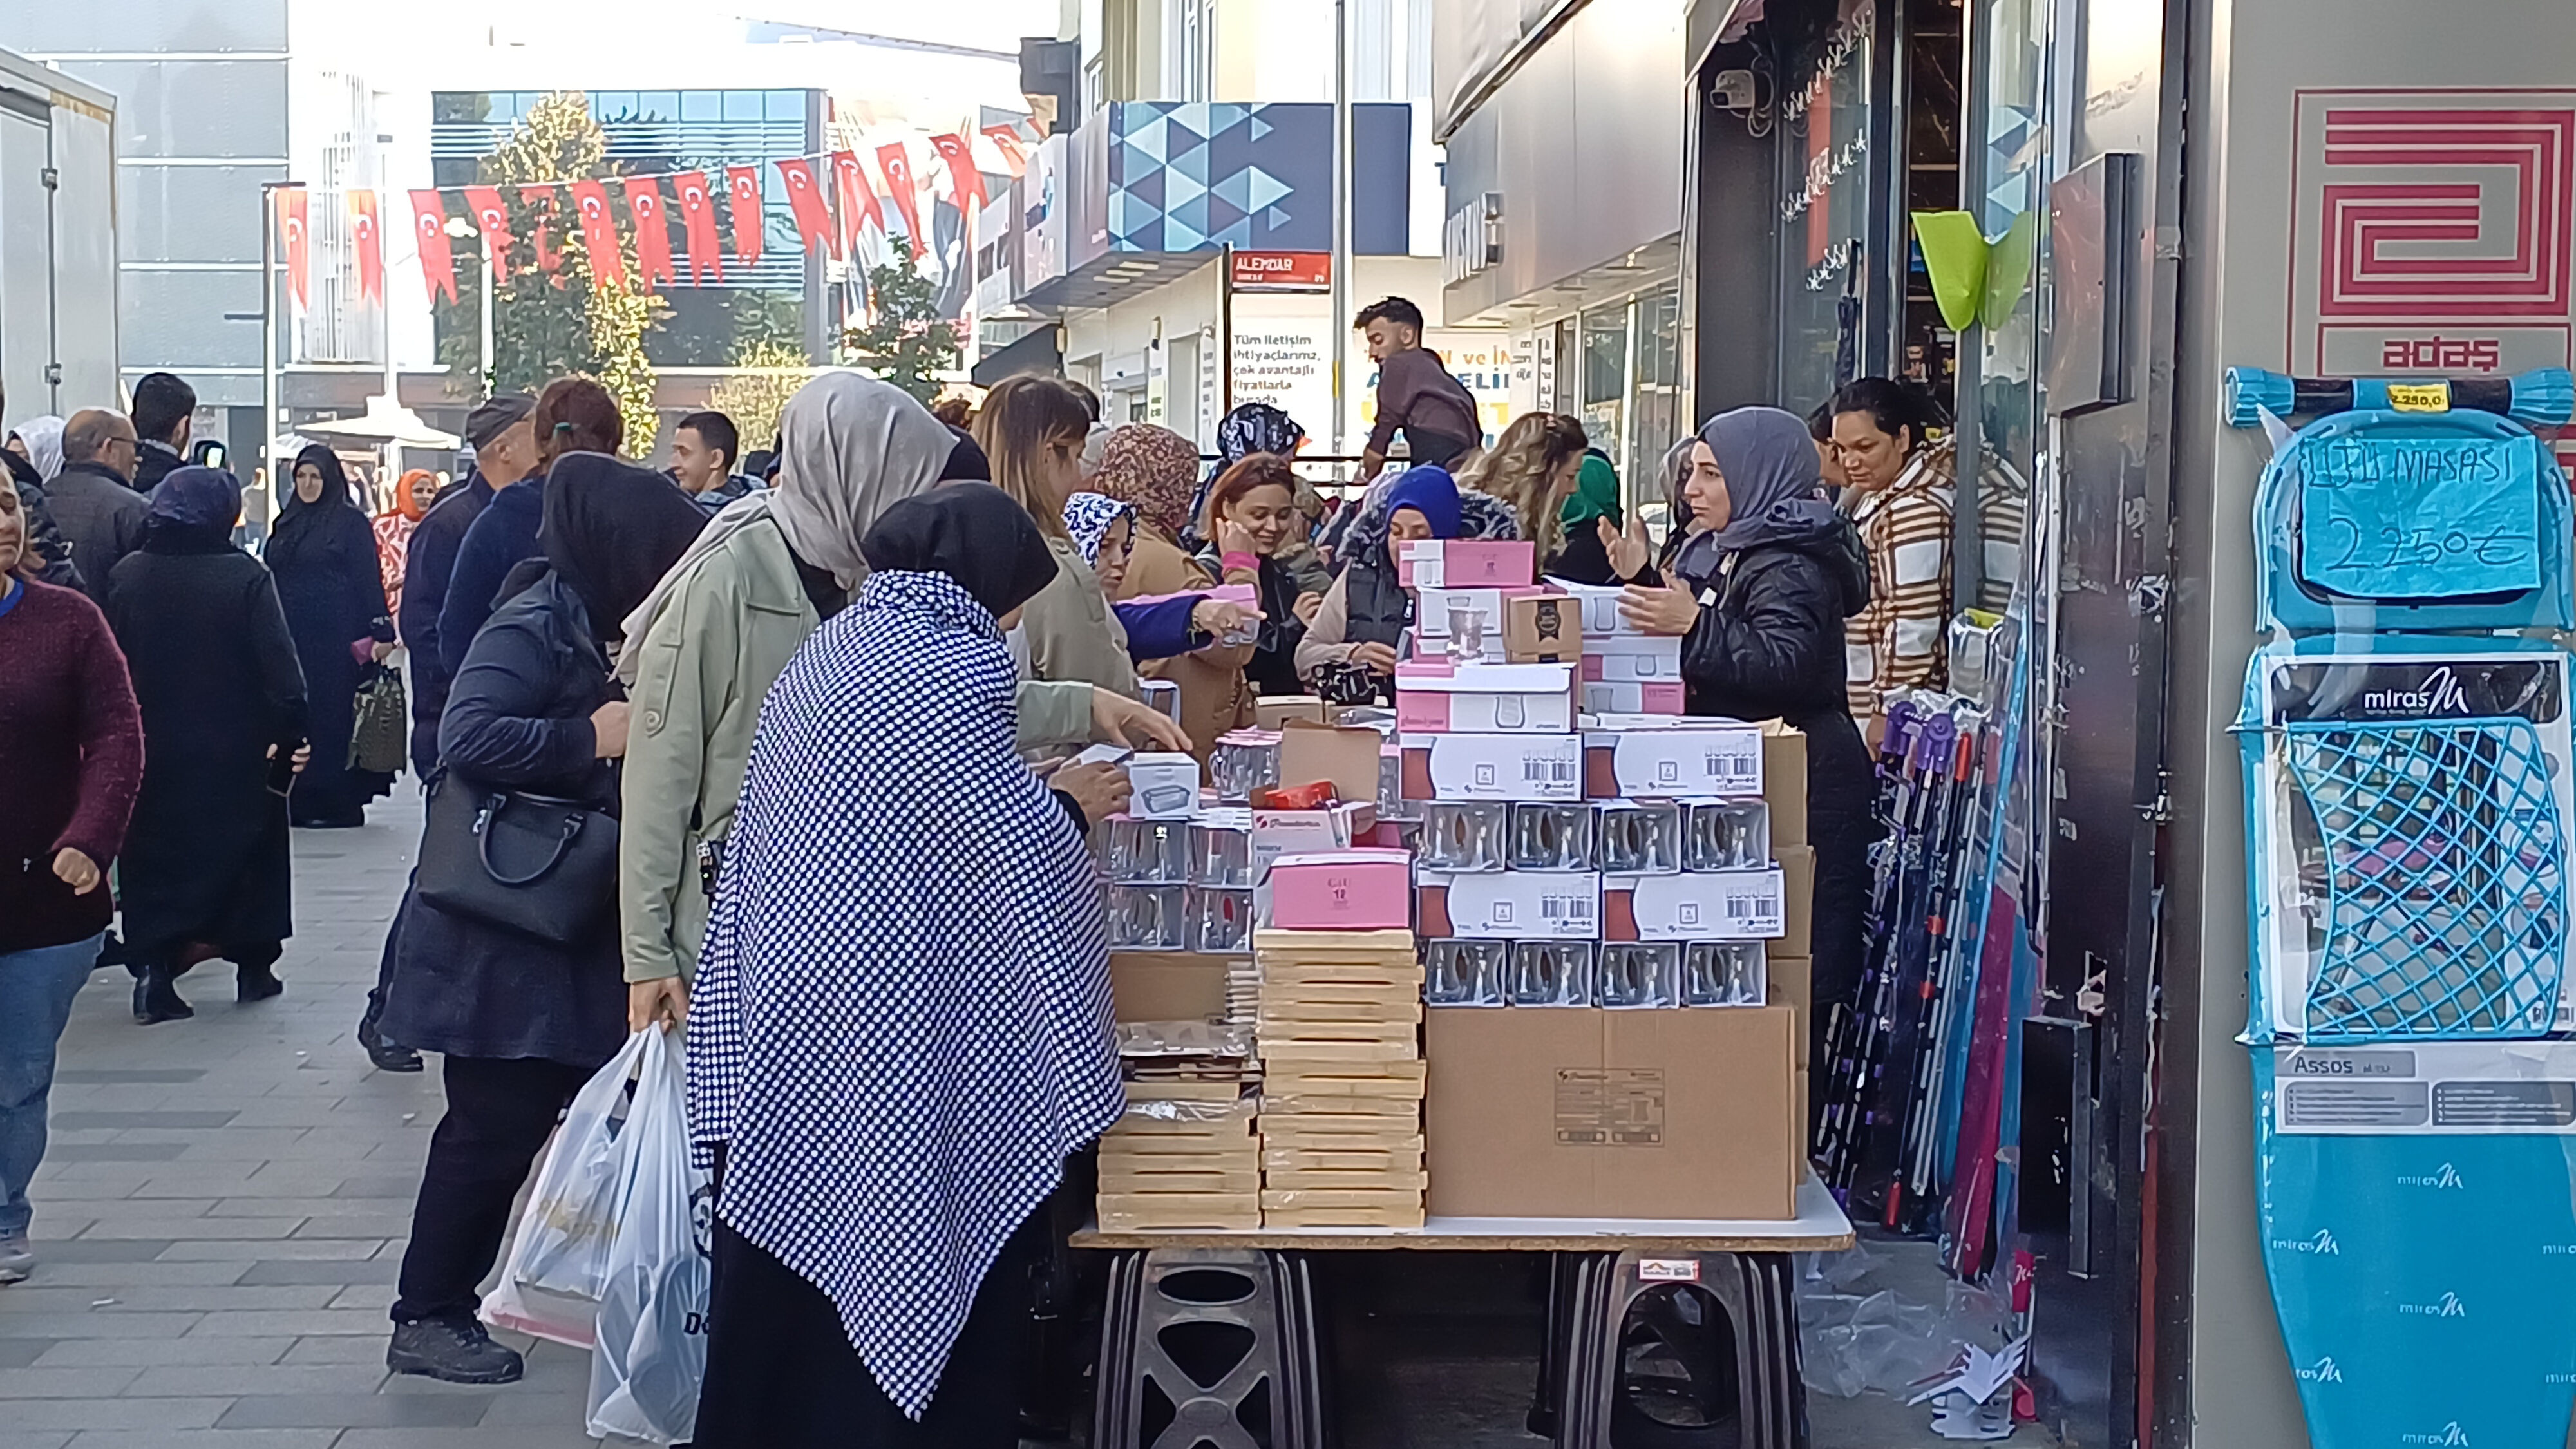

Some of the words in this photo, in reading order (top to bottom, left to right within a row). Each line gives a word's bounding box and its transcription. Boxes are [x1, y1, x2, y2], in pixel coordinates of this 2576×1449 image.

[1233, 334, 1262, 345] Tüm
[2394, 446, 2512, 486] MASASI
[2294, 1056, 2353, 1074] Assos
